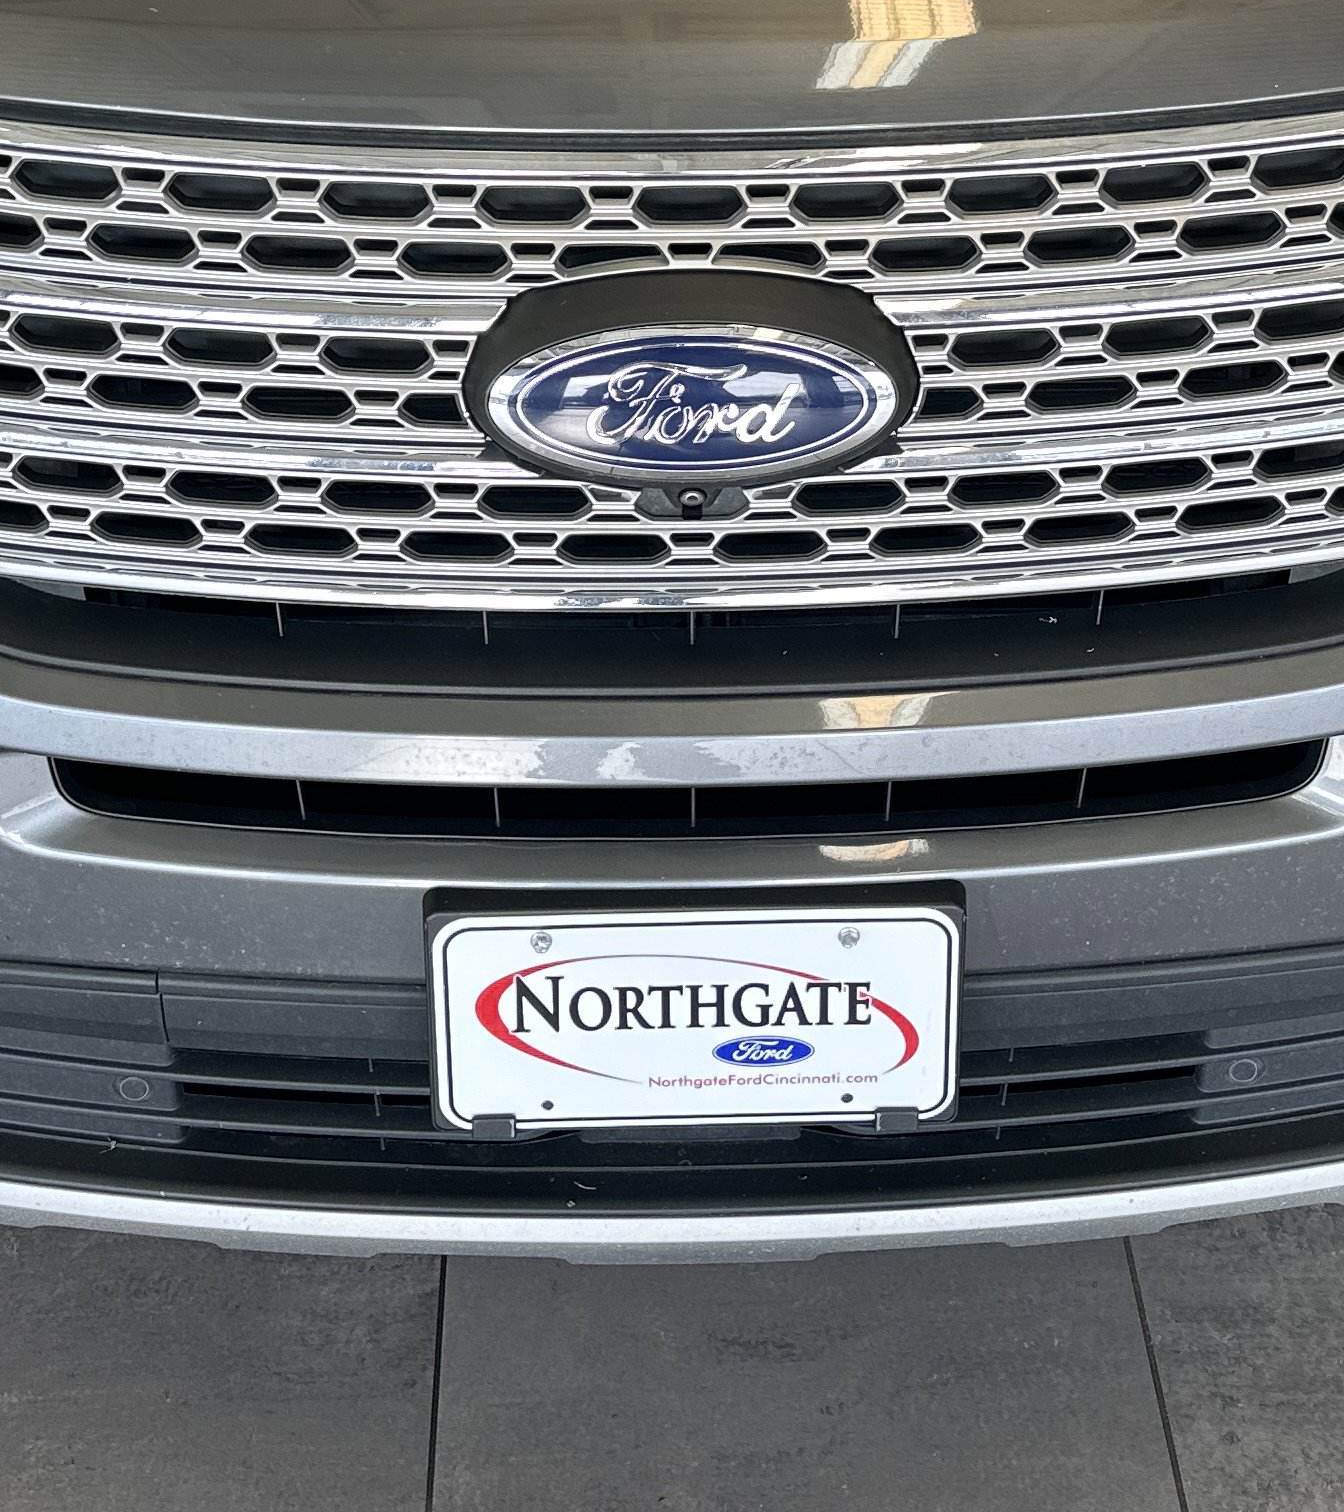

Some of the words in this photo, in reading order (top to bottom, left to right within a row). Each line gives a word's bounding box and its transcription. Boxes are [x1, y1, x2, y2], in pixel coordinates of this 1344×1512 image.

[586, 360, 801, 445] Ford
[511, 975, 873, 1033] NORTHGATE
[731, 1041, 795, 1061] Ford
[648, 1073, 879, 1090] NorthgateFordCincinnati.com
